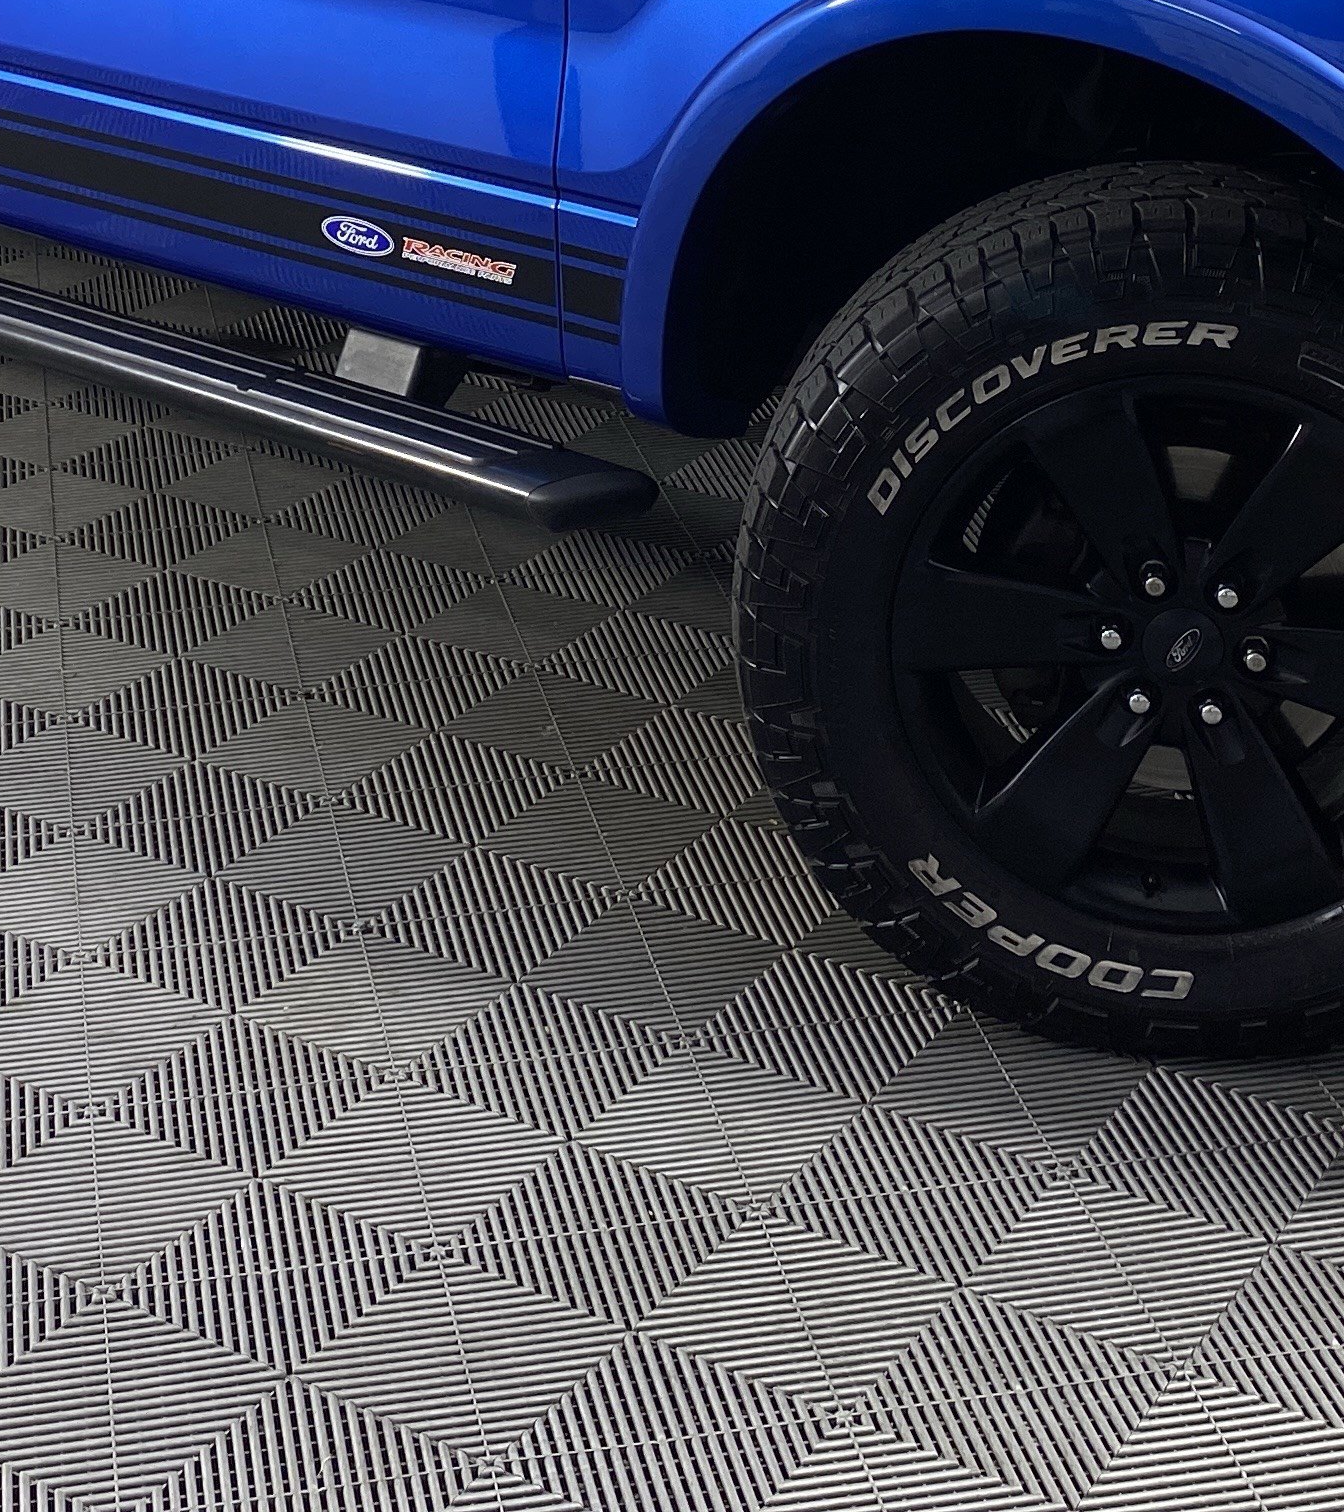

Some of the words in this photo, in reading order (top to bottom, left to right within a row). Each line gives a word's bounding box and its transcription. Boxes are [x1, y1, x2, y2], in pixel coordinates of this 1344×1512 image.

[334, 219, 381, 251] Ford
[401, 236, 517, 279] RACING
[866, 320, 1241, 517] DISCOVERER
[907, 851, 1196, 1001] COOPER
